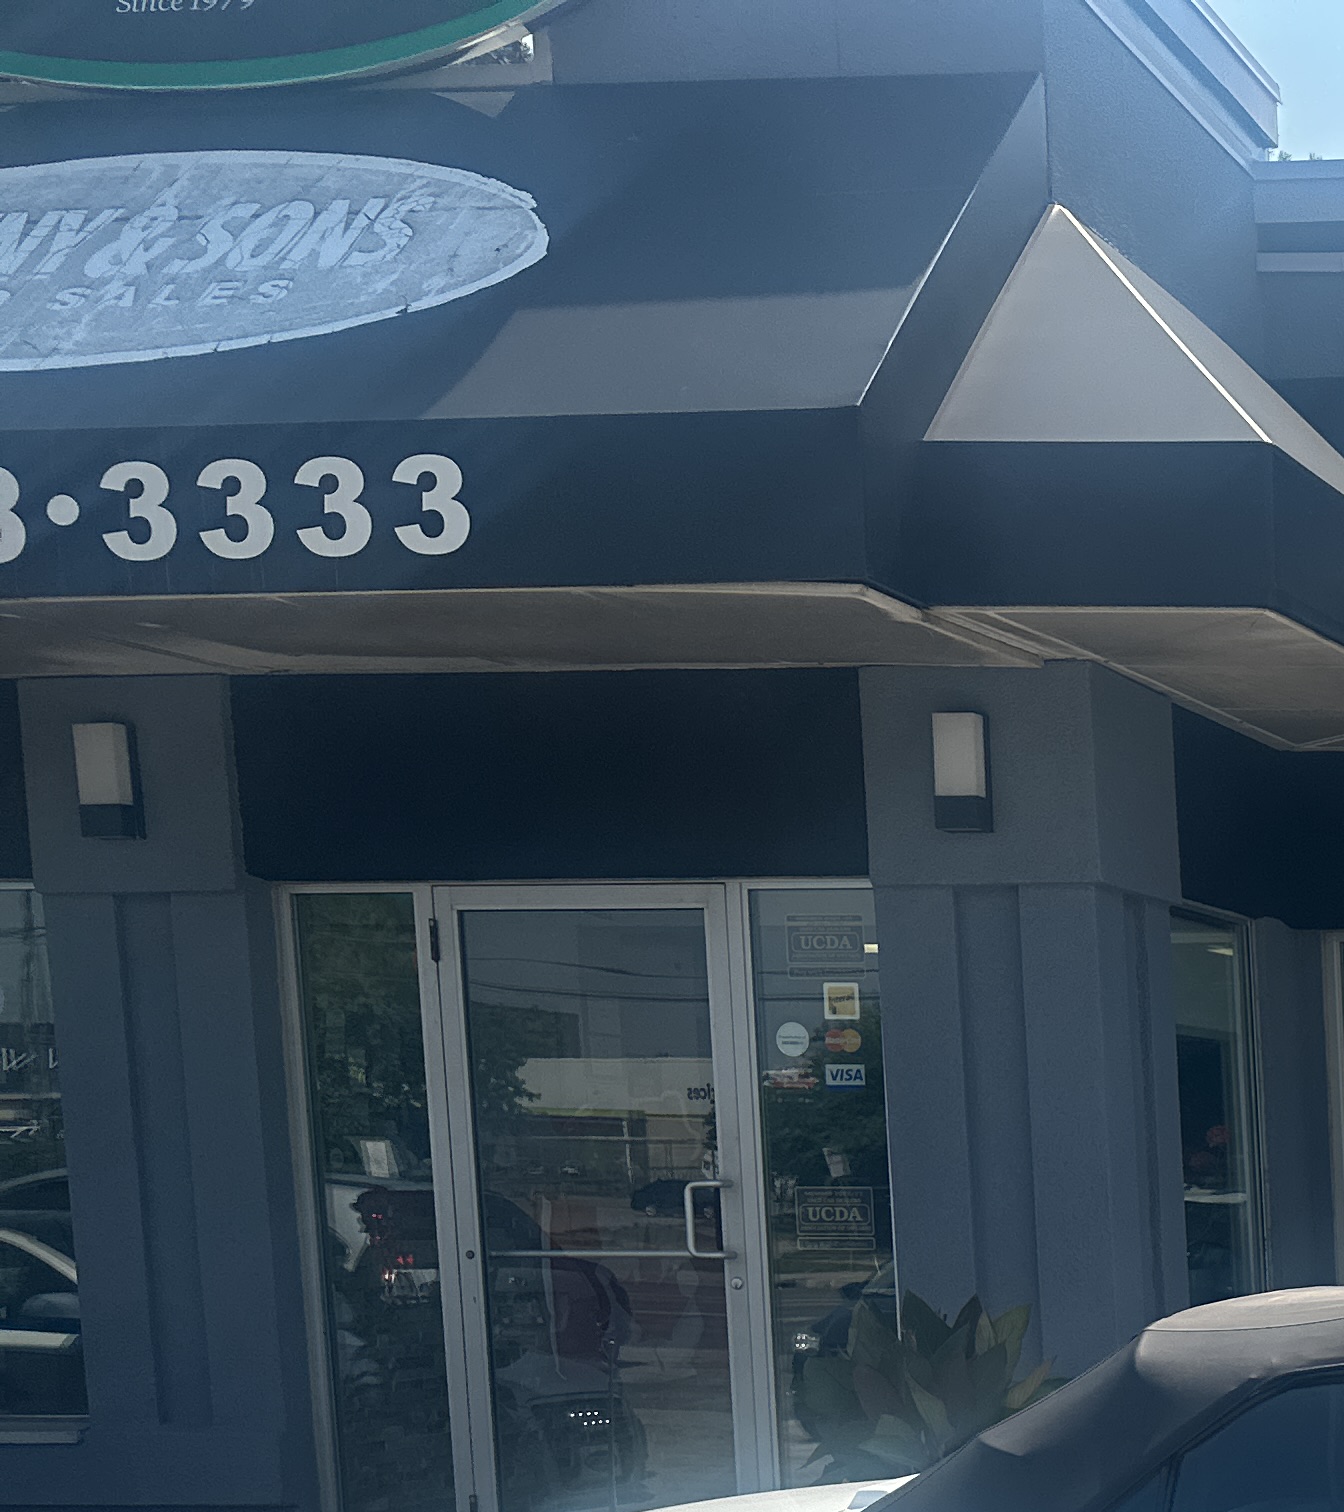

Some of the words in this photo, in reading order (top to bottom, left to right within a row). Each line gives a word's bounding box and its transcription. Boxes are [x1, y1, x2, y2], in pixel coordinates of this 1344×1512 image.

[162, 196, 437, 273] SONS
[47, 279, 294, 310] SALES
[799, 935, 853, 950] UCDA
[829, 1068, 864, 1082] VISA
[806, 1206, 863, 1221] UCDA
